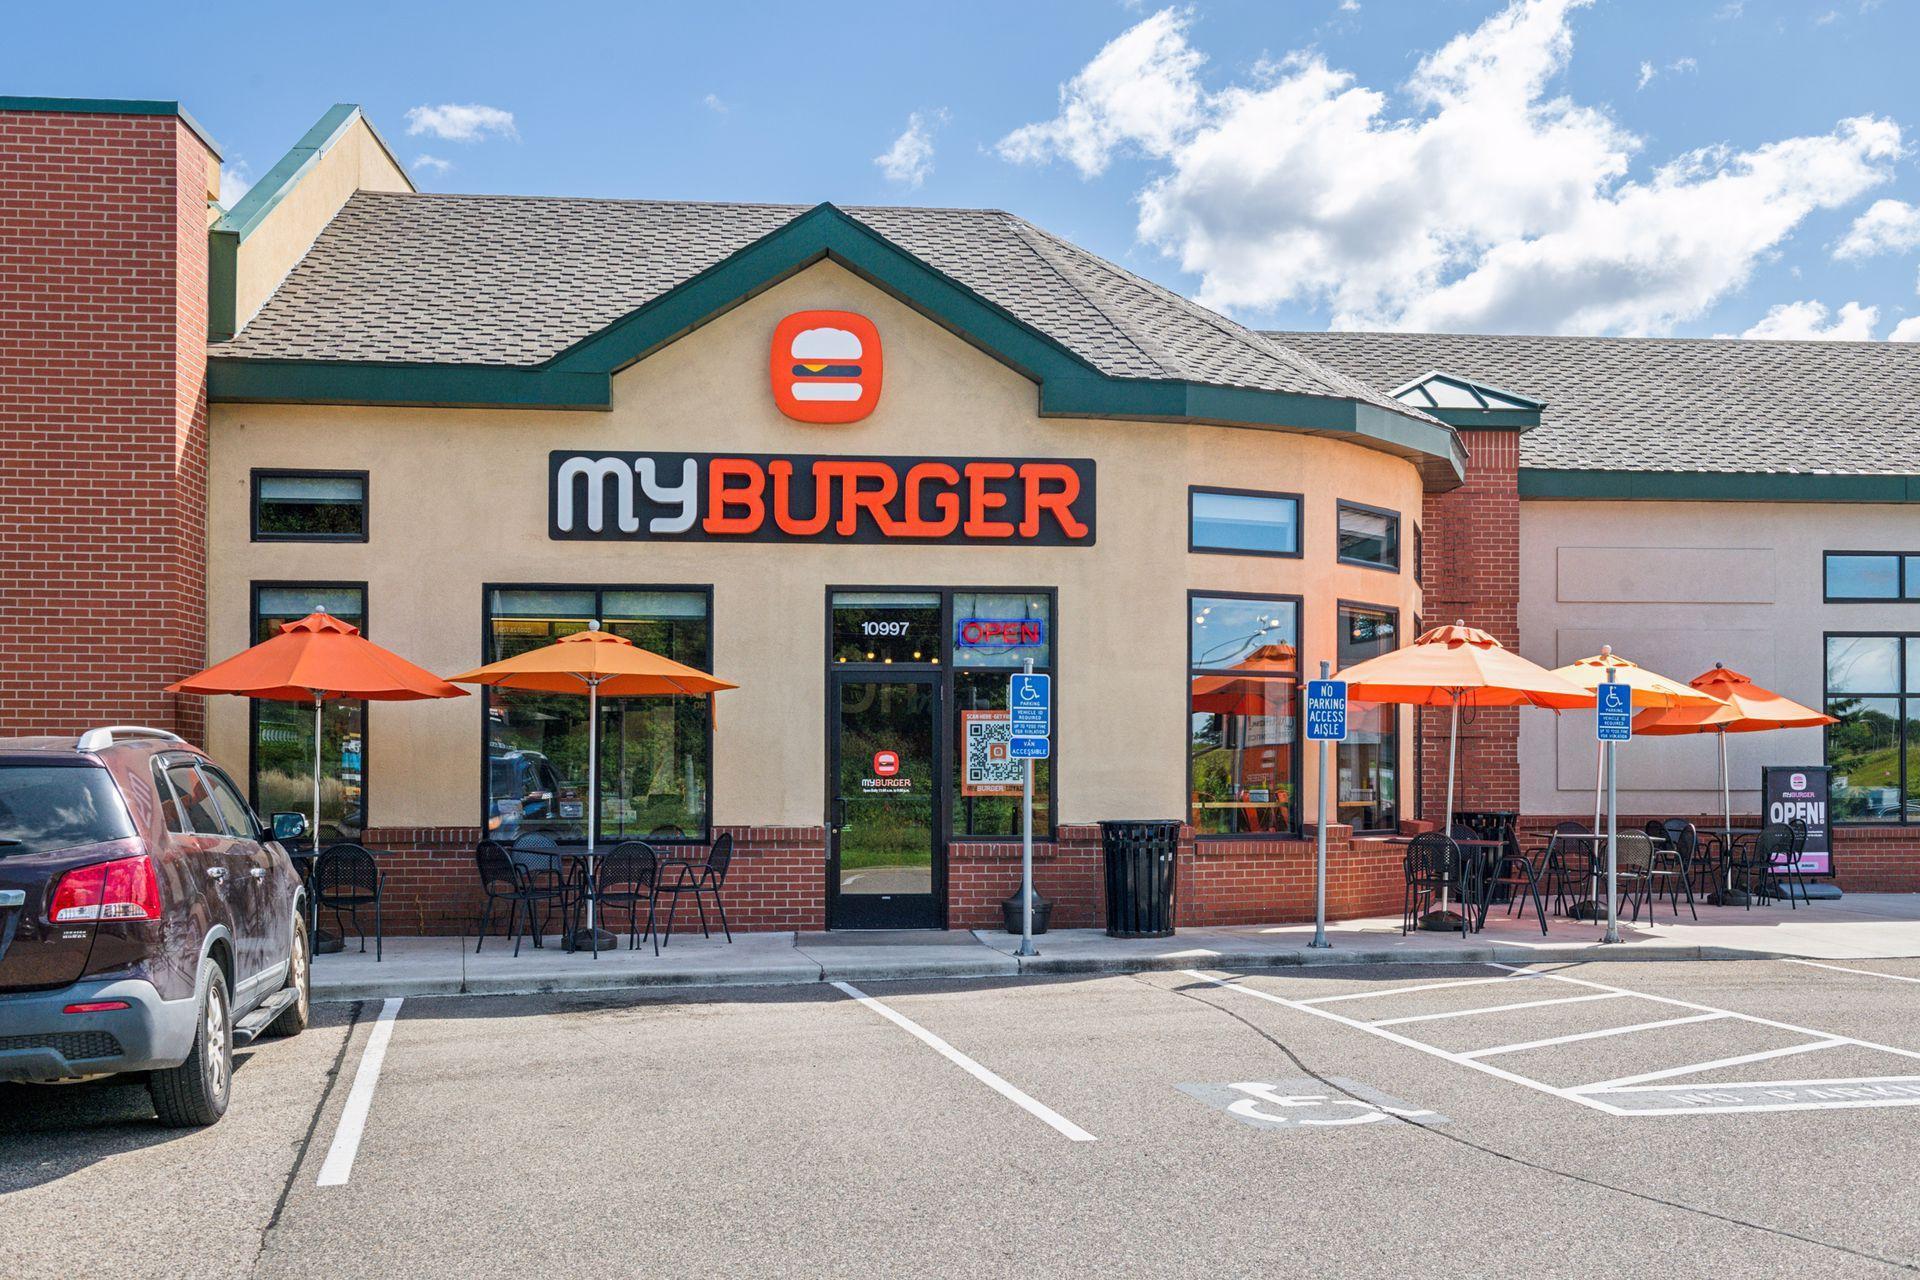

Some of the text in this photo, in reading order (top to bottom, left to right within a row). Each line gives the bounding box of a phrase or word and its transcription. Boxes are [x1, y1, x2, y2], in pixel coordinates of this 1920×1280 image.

[861, 622, 910, 636] 10997
[962, 622, 1039, 644] OPEN
[1321, 686, 1333, 697] NO
[1309, 698, 1344, 710] PARKING
[1310, 710, 1344, 722] ACCESS
[1314, 724, 1340, 735] AISLE
[1770, 801, 1825, 825] OPEN!
[1762, 1084, 1920, 1100] PARKI
